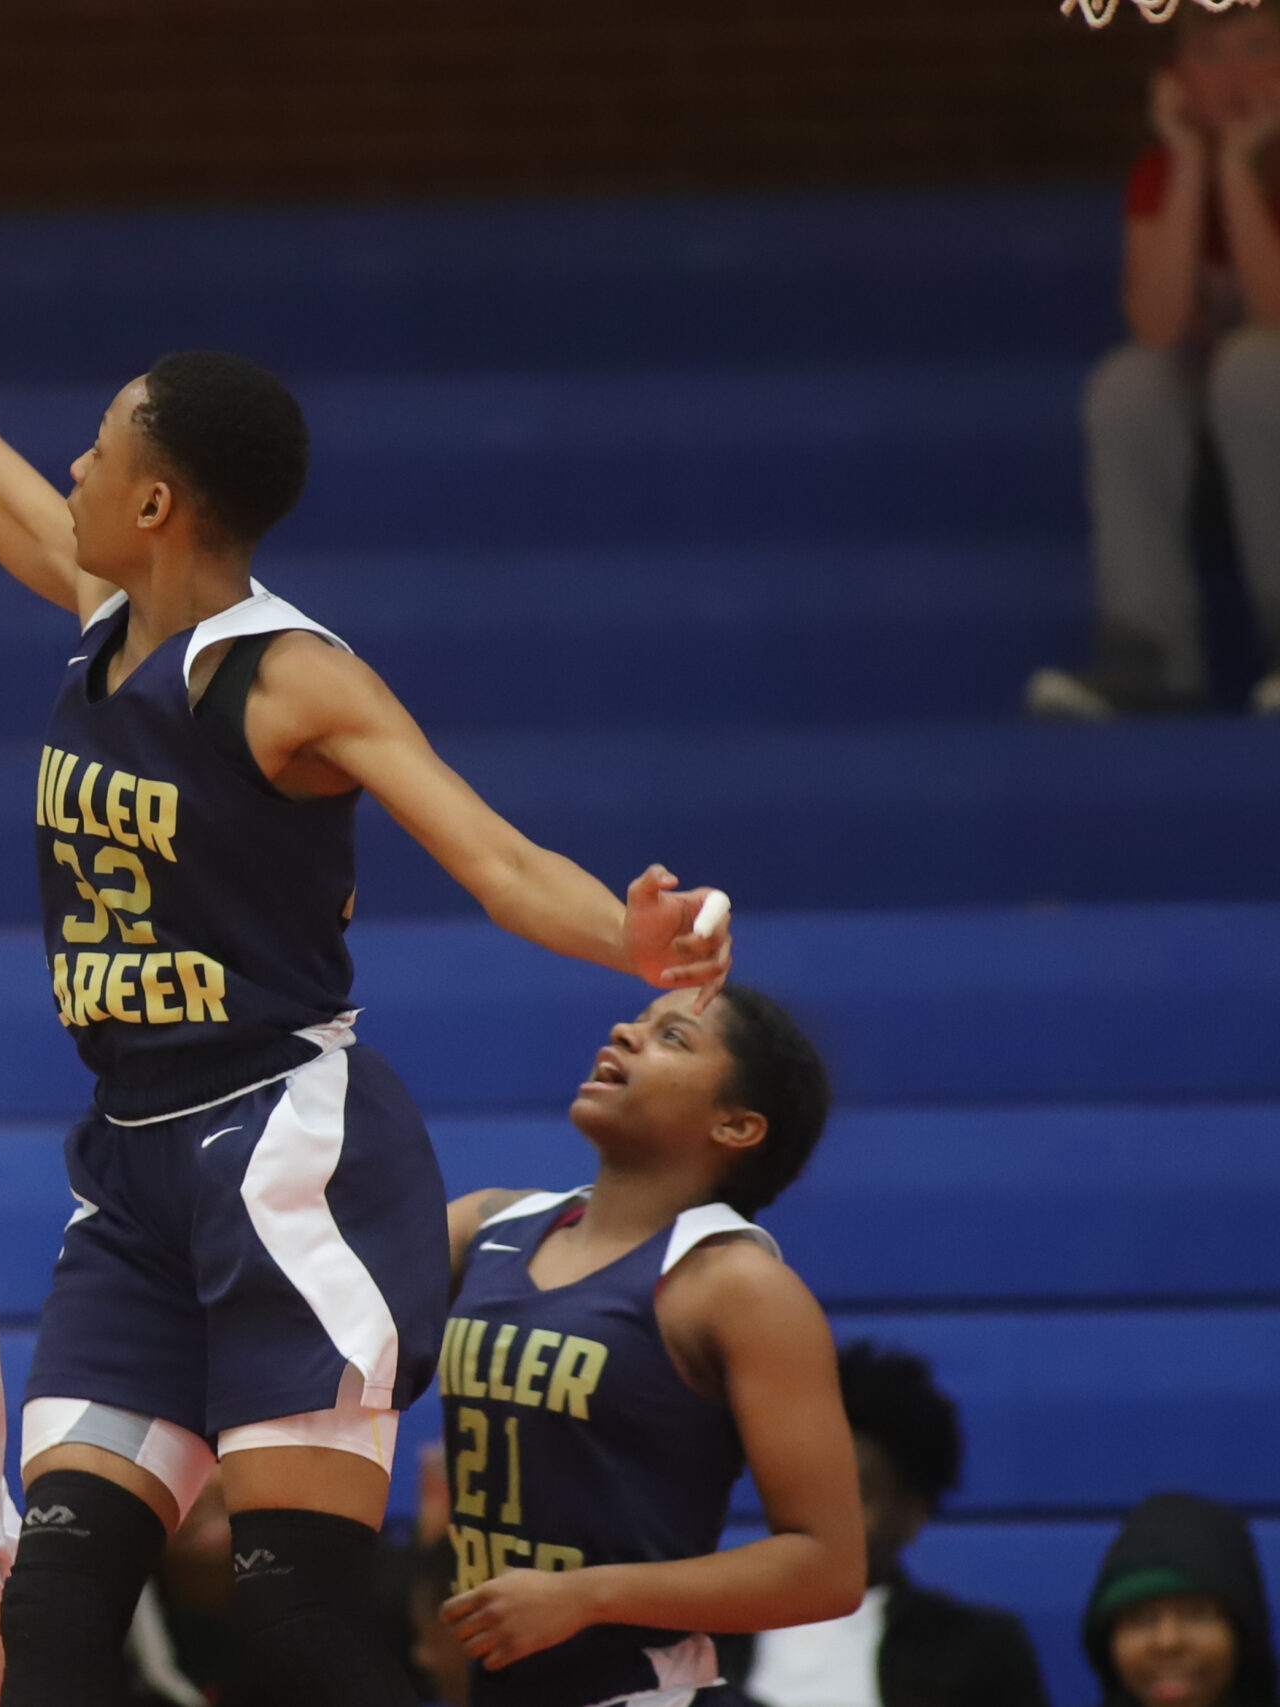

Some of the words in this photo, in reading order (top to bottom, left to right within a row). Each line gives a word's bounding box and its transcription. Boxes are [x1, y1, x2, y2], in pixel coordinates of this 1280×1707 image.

[53, 839, 158, 944] 32
[52, 950, 230, 1027] AREER
[454, 1406, 524, 1525] 21
